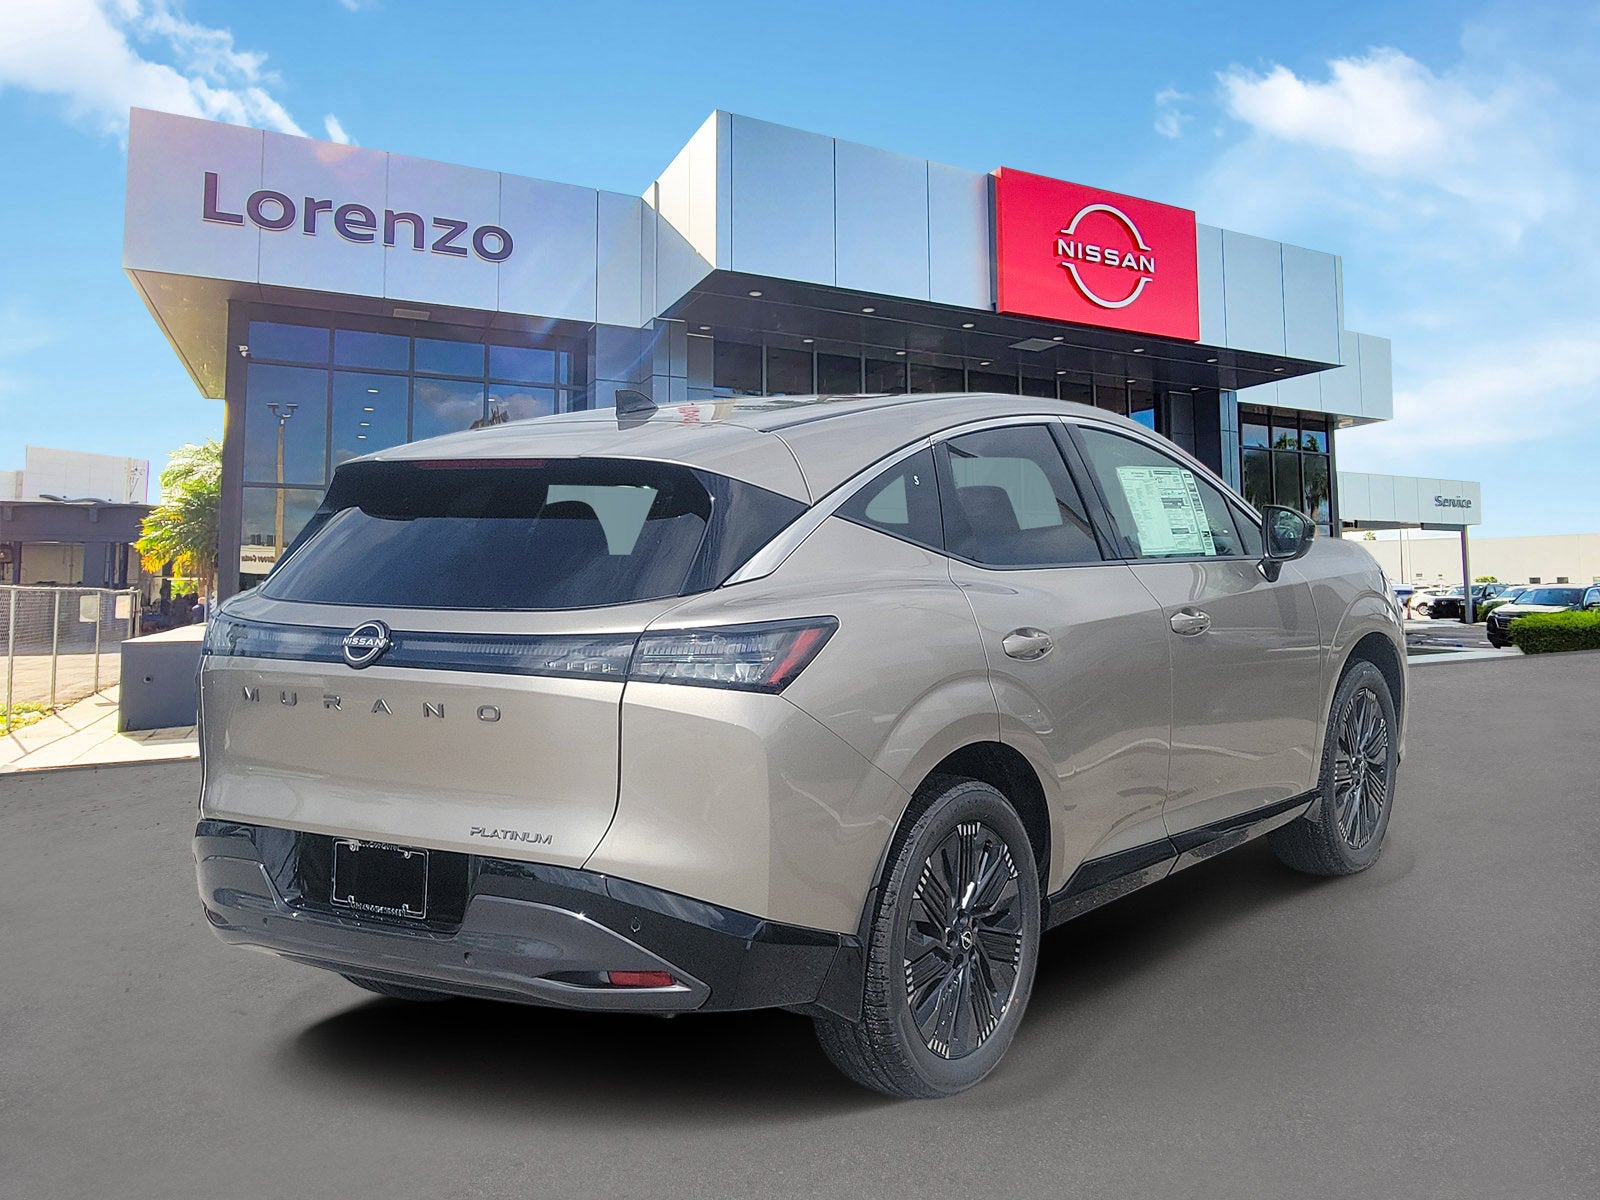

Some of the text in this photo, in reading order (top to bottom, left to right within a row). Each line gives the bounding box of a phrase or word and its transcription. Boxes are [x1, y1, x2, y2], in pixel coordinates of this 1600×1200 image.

[202, 171, 514, 262] Lorenzo
[1057, 238, 1155, 273] NISSAN
[1434, 495, 1472, 508] Service
[342, 637, 387, 648] NISSAN
[241, 686, 502, 722] MURANO
[470, 826, 553, 845] PLATINUM
